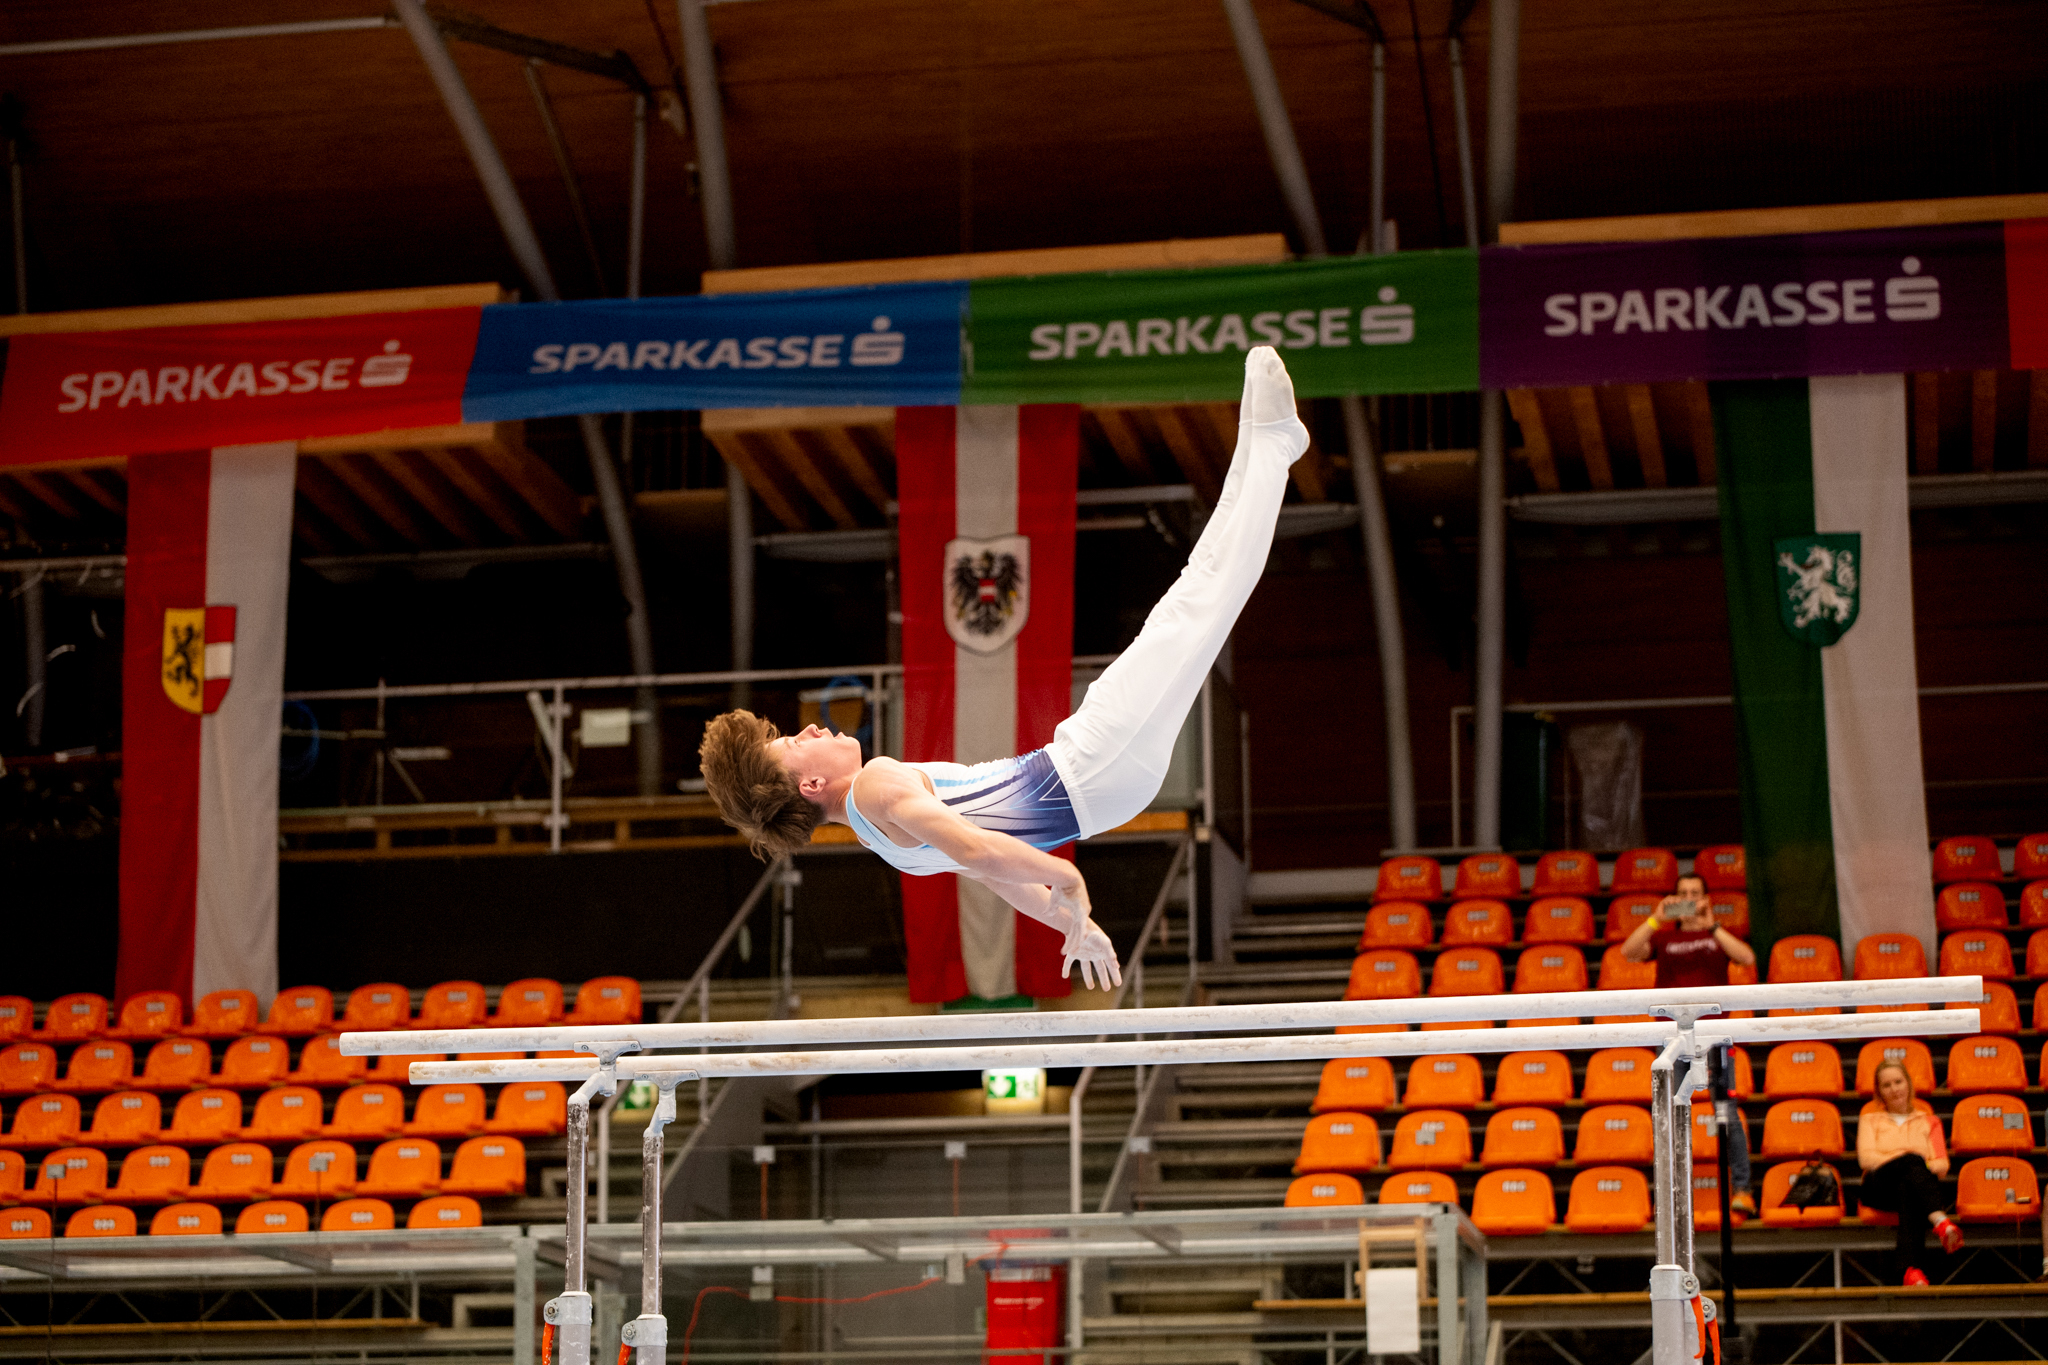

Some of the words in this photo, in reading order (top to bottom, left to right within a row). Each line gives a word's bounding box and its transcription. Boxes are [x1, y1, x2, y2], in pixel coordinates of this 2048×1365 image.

[1029, 307, 1351, 360] SPARKASSE
[1544, 279, 1876, 336] SPARKASSE
[530, 334, 844, 374] SPARKASSE
[58, 357, 354, 413] SPARKASSE
